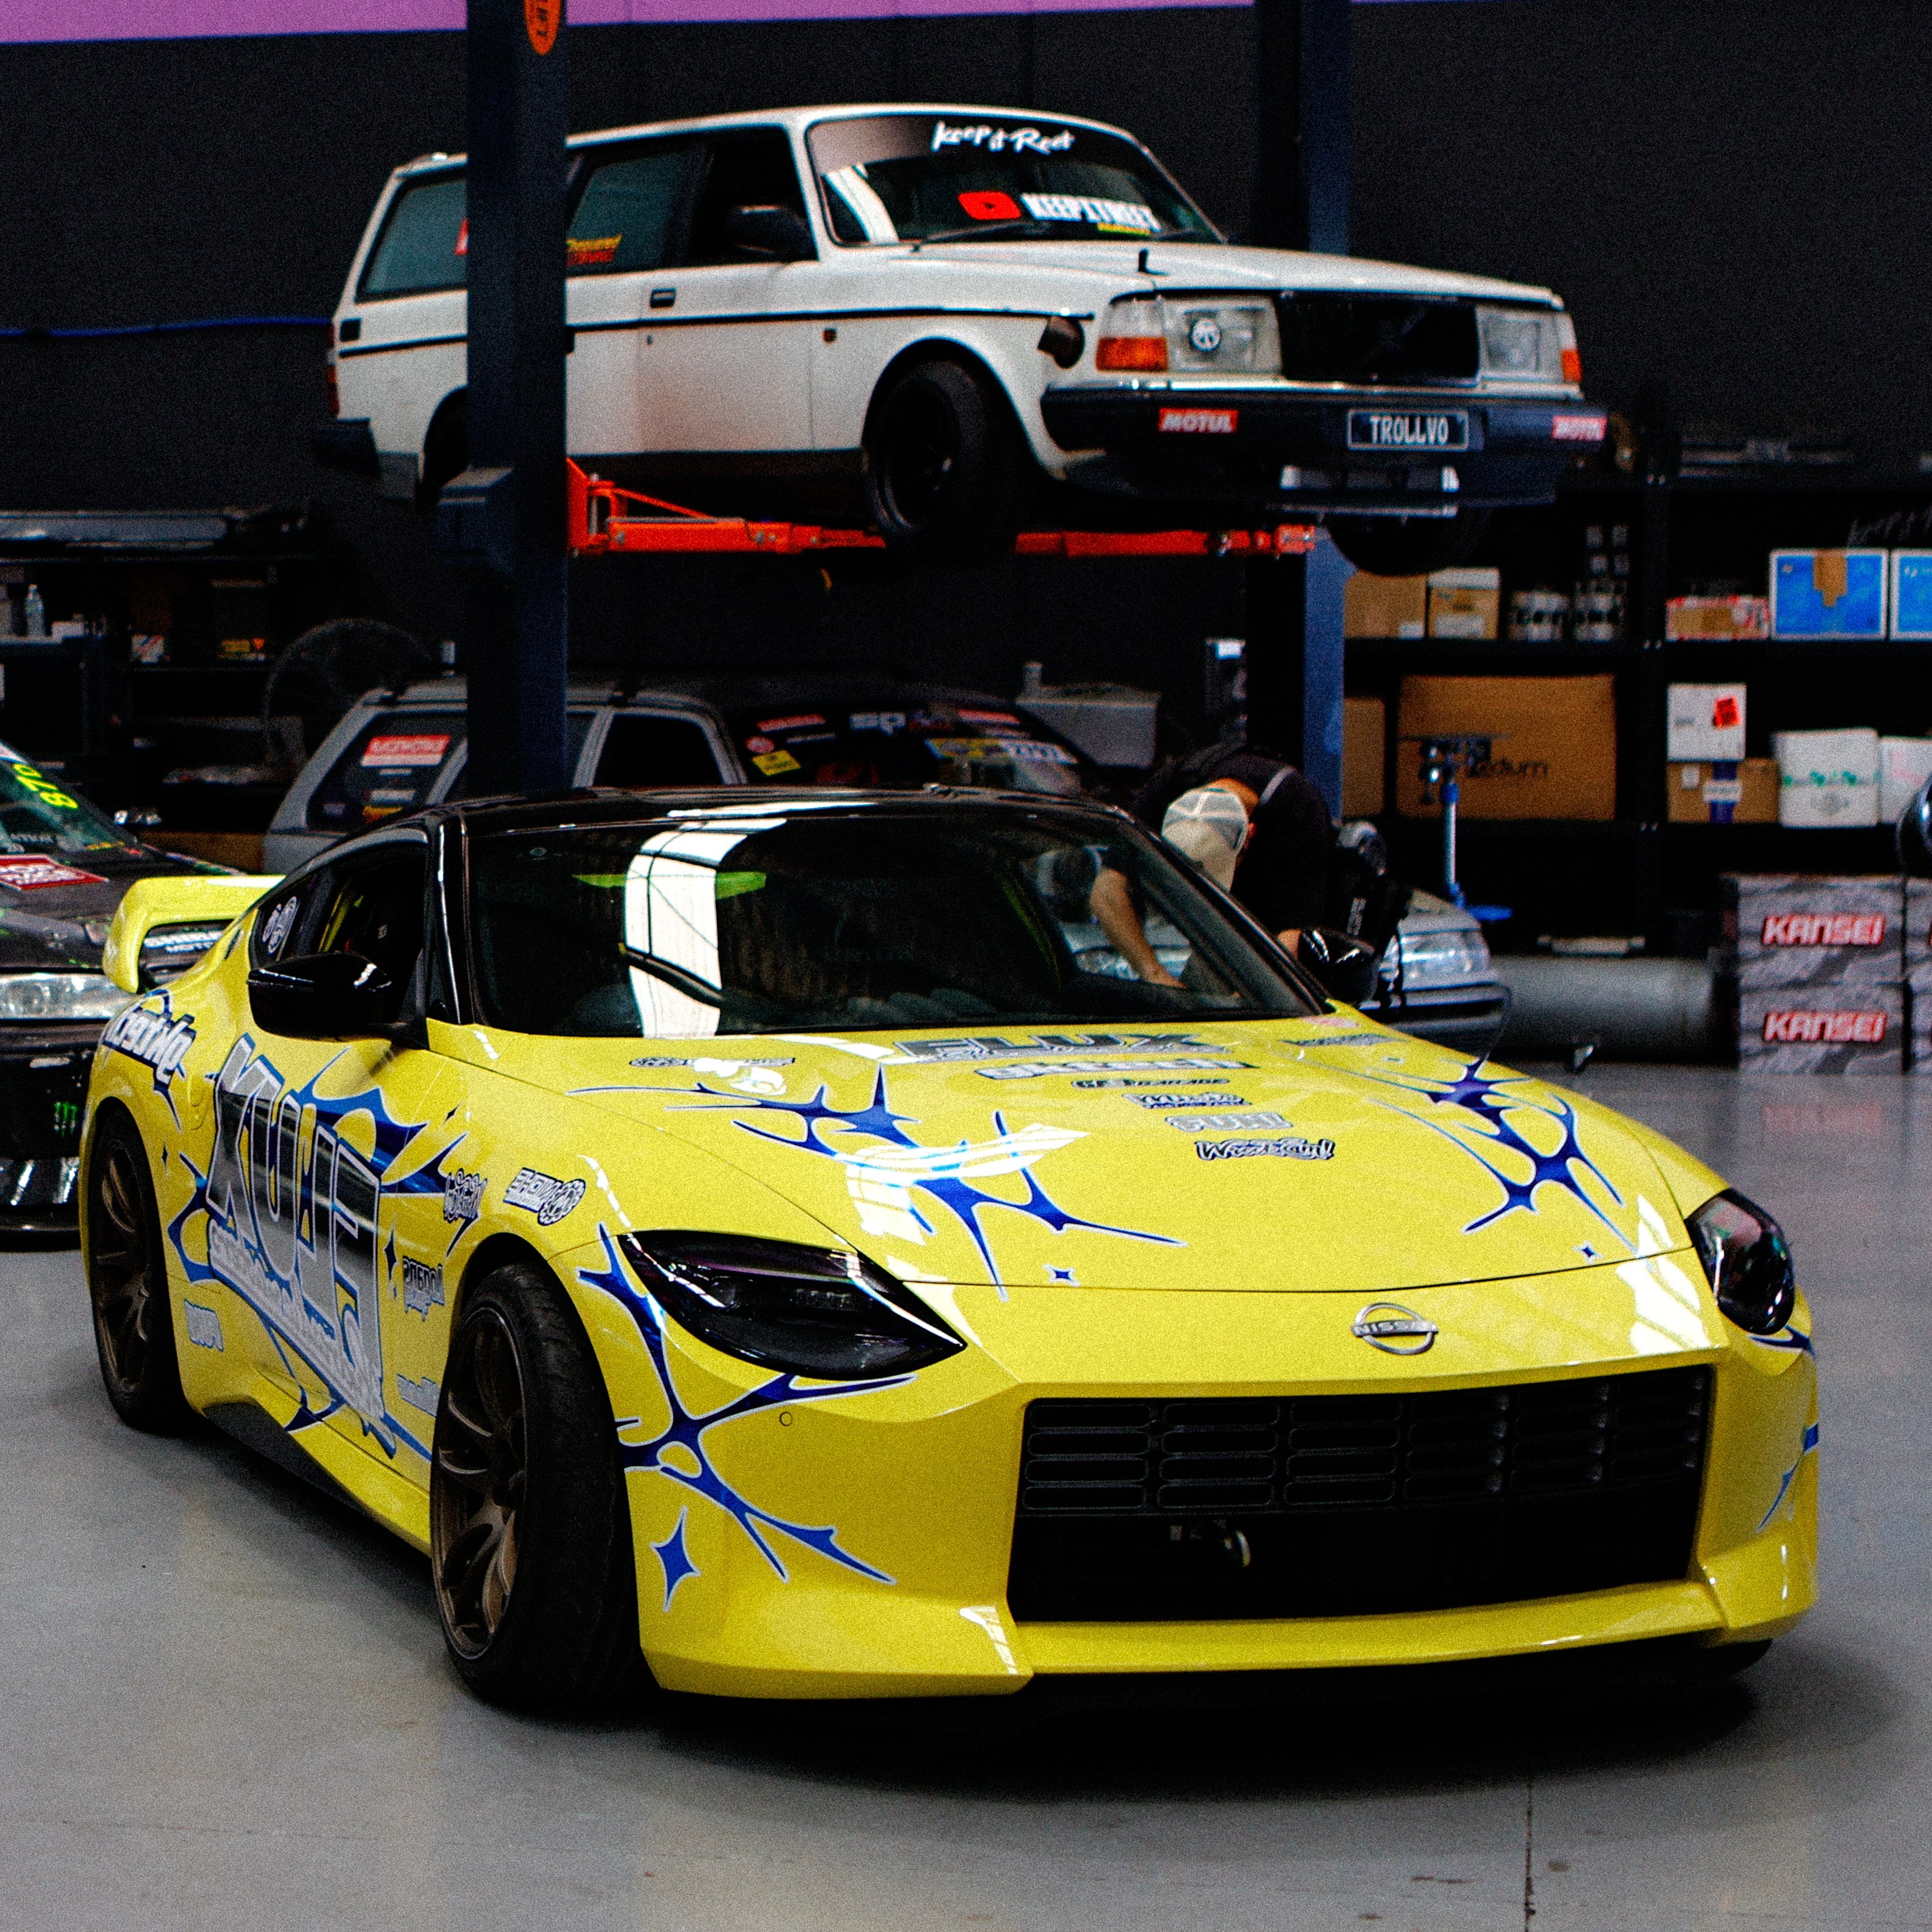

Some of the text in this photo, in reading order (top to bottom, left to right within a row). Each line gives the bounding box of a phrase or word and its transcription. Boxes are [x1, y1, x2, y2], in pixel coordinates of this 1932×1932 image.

[1161, 413, 1233, 433] MOTUL
[1369, 415, 1449, 445] TROLLVO
[1762, 915, 1885, 945] KANSEI
[1763, 1012, 1887, 1042] KANSEI
[893, 1033, 1220, 1059] FLUX
